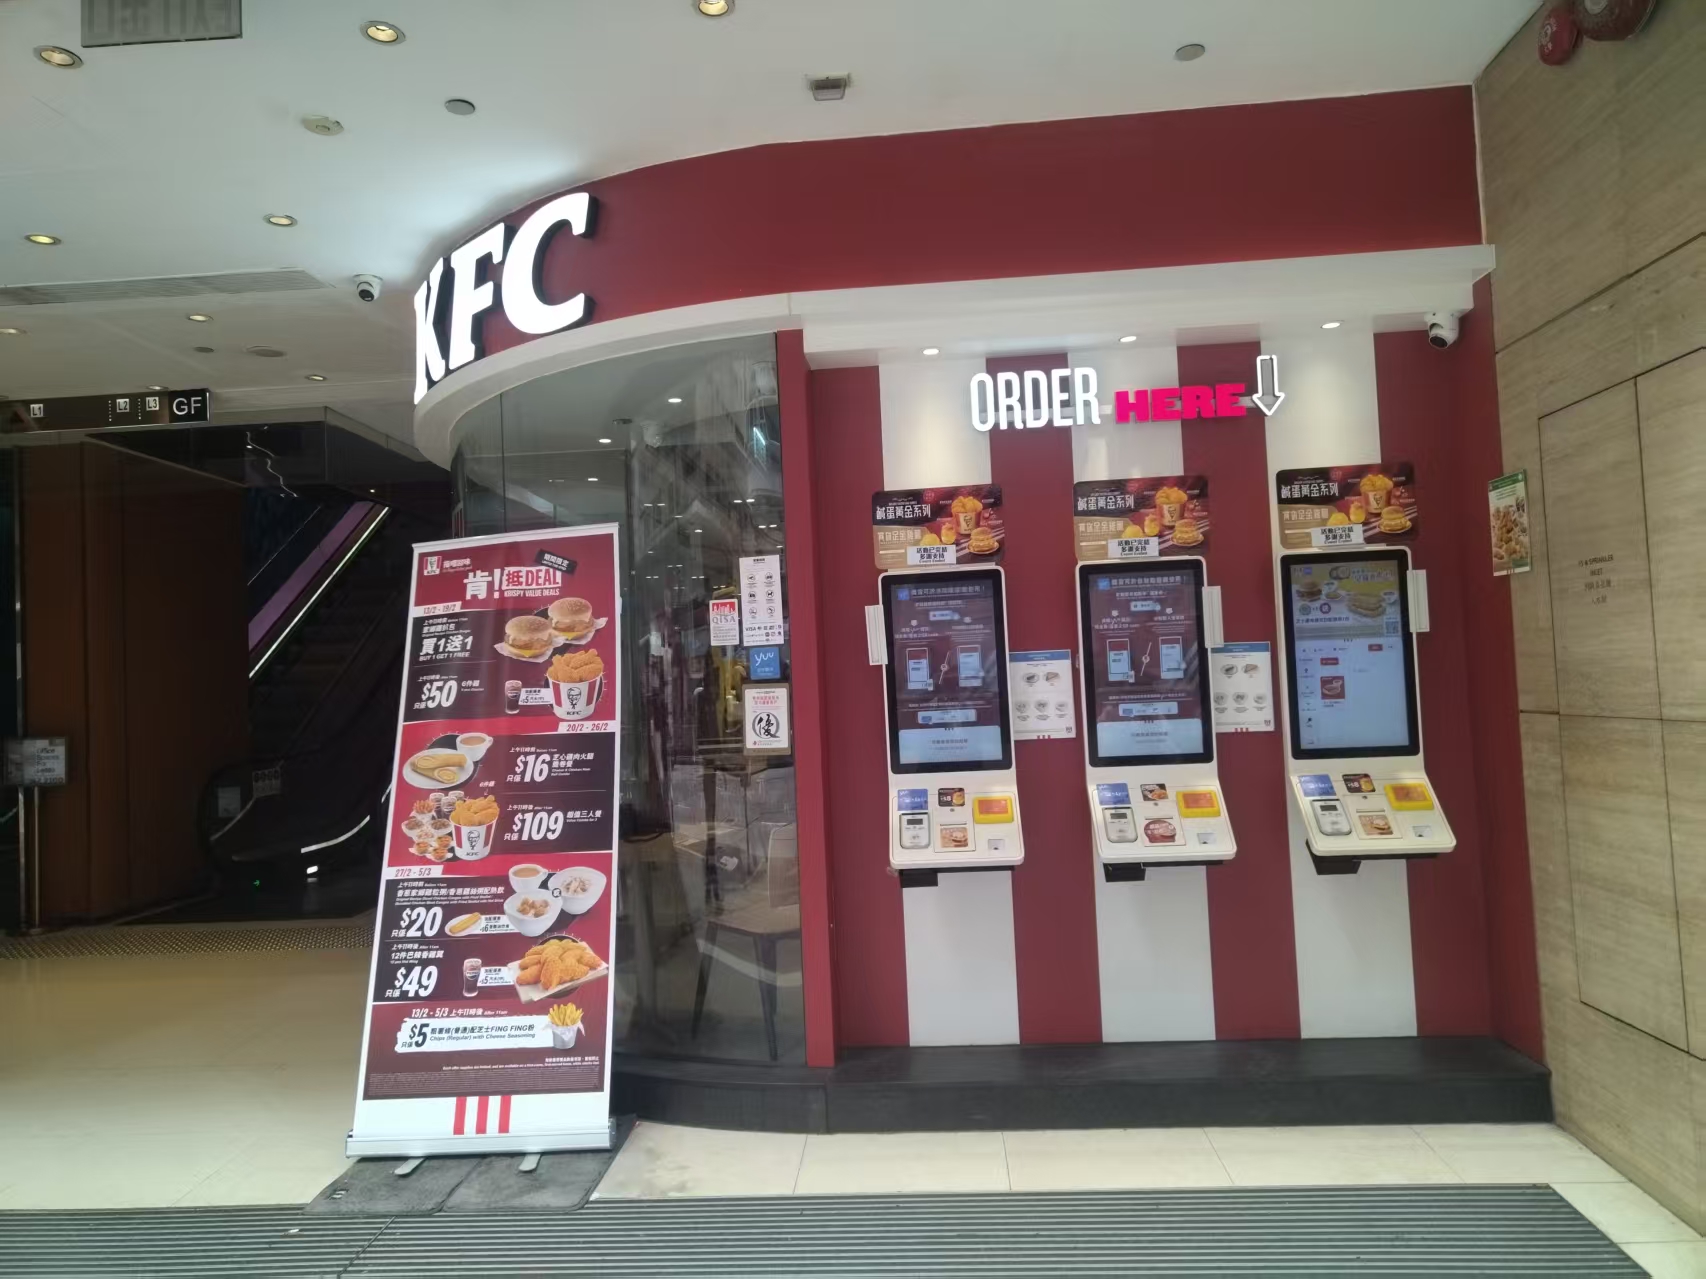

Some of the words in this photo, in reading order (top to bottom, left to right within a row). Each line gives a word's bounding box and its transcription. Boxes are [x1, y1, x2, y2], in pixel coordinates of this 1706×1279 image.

[414, 191, 590, 405] KFC
[32, 405, 42, 416] L1
[117, 400, 128, 411] L2
[147, 398, 158, 409] L3
[172, 396, 202, 416] GF
[970, 367, 1101, 432] ORDER
[1115, 383, 1246, 424] HERE
[1281, 482, 1339, 498] 鹹蛋黃金系列
[876, 503, 932, 520] 鹹蛋黃金系列
[1077, 494, 1135, 511] 鹹蛋黃金系列
[504, 588, 524, 597] KRISPY
[525, 588, 542, 597] VALUE
[542, 588, 560, 596] DEALS
[419, 634, 473, 655] 買1送1
[754, 652, 774, 666] yuu
[421, 680, 458, 708] $50
[566, 723, 584, 732] 20/2
[591, 722, 608, 731] 26/2
[515, 753, 551, 782] $16
[512, 811, 564, 841] $109
[395, 868, 412, 877] 27/2
[418, 867, 431, 876] 5/3
[400, 906, 443, 937] $20
[391, 929, 406, 937] 只係
[394, 966, 438, 997] $49
[385, 989, 400, 997] 只係
[411, 1008, 428, 1018] 13/2
[435, 1008, 449, 1017] 5/3
[450, 1008, 483, 1016] 上午11時後
[409, 1023, 430, 1047] $5
